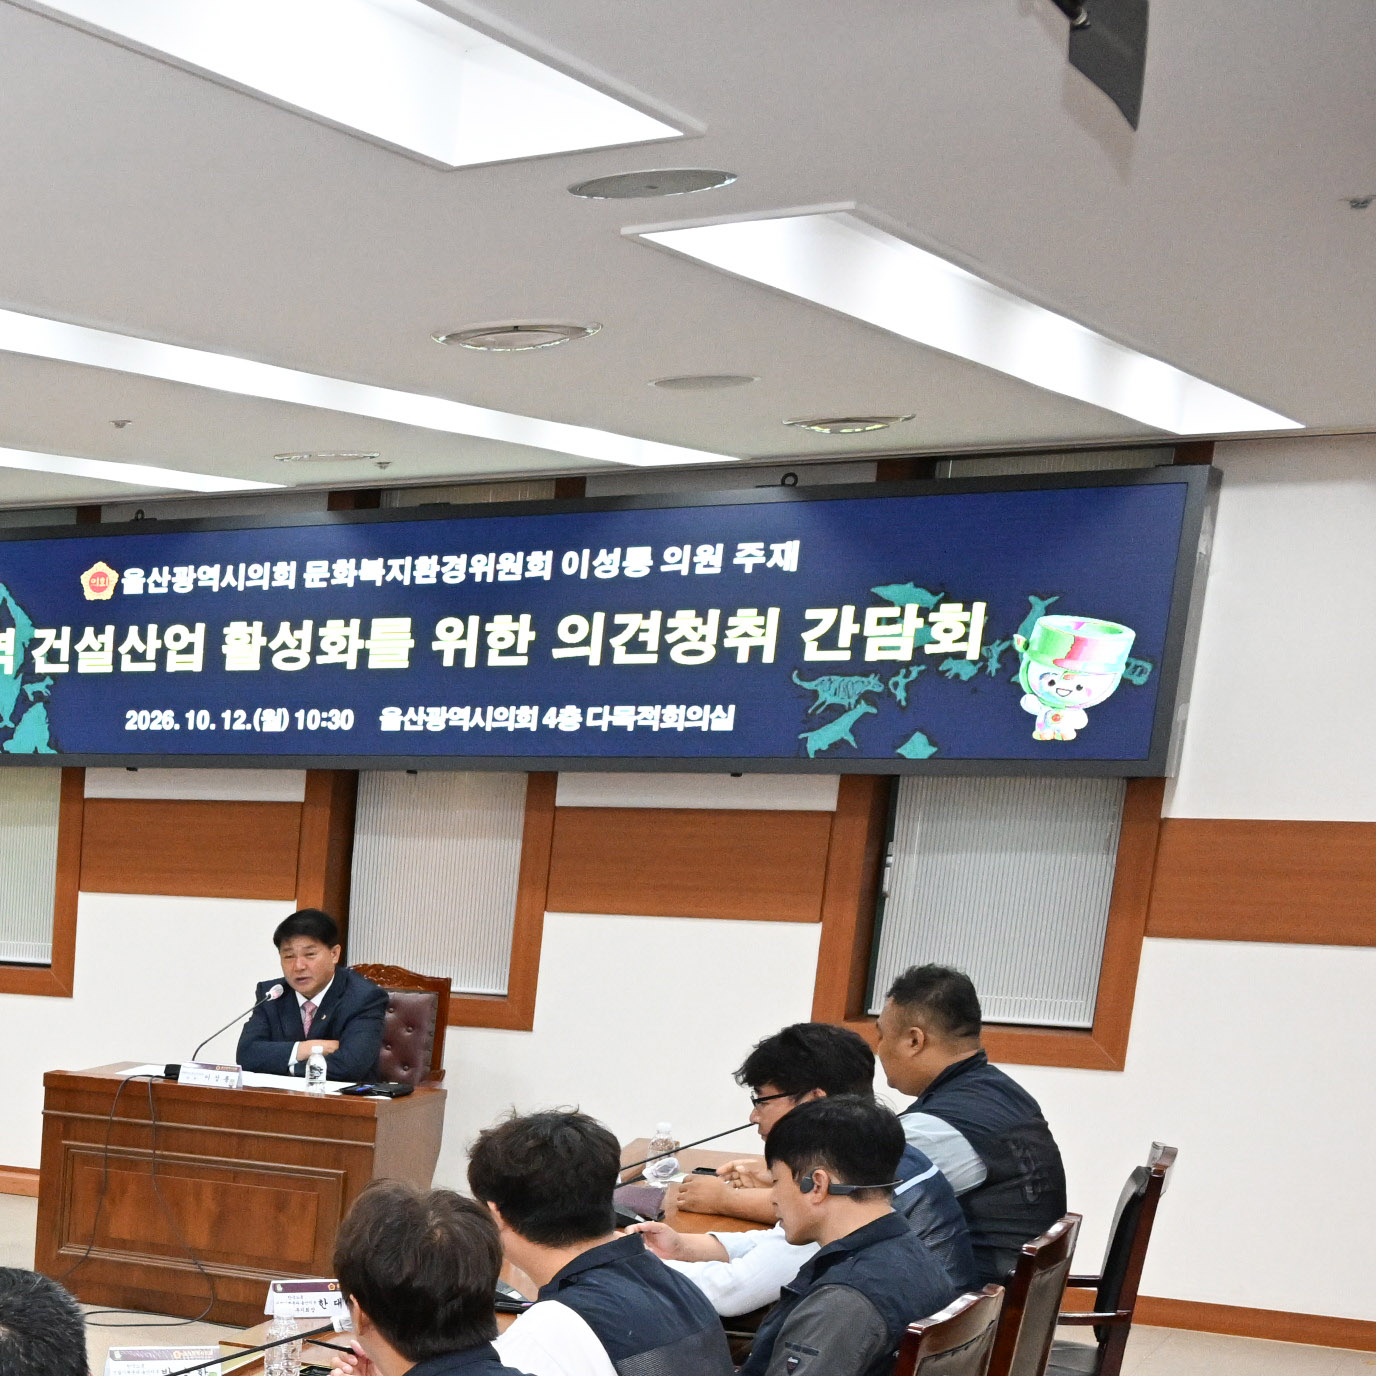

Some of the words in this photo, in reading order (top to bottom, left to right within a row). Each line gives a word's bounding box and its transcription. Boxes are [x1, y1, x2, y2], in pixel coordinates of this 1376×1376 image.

[121, 561, 296, 594] 울산광역시의회
[303, 551, 553, 585] 문화복지환경위원회
[660, 543, 724, 575] 의원
[733, 539, 800, 573] 주재
[31, 623, 205, 673] 건설산업
[221, 618, 414, 671] 활성화를
[432, 614, 535, 667] 위한
[551, 607, 780, 666] 의견청취
[800, 602, 987, 661] 간담회
[124, 709, 181, 731] 2026.
[184, 709, 216, 731] 10.
[221, 707, 290, 732] 12.(월)
[294, 708, 355, 731] 10:30
[379, 706, 539, 732] 울산광역시의회
[542, 705, 583, 731] 4층
[586, 705, 736, 731] 다목적회의실
